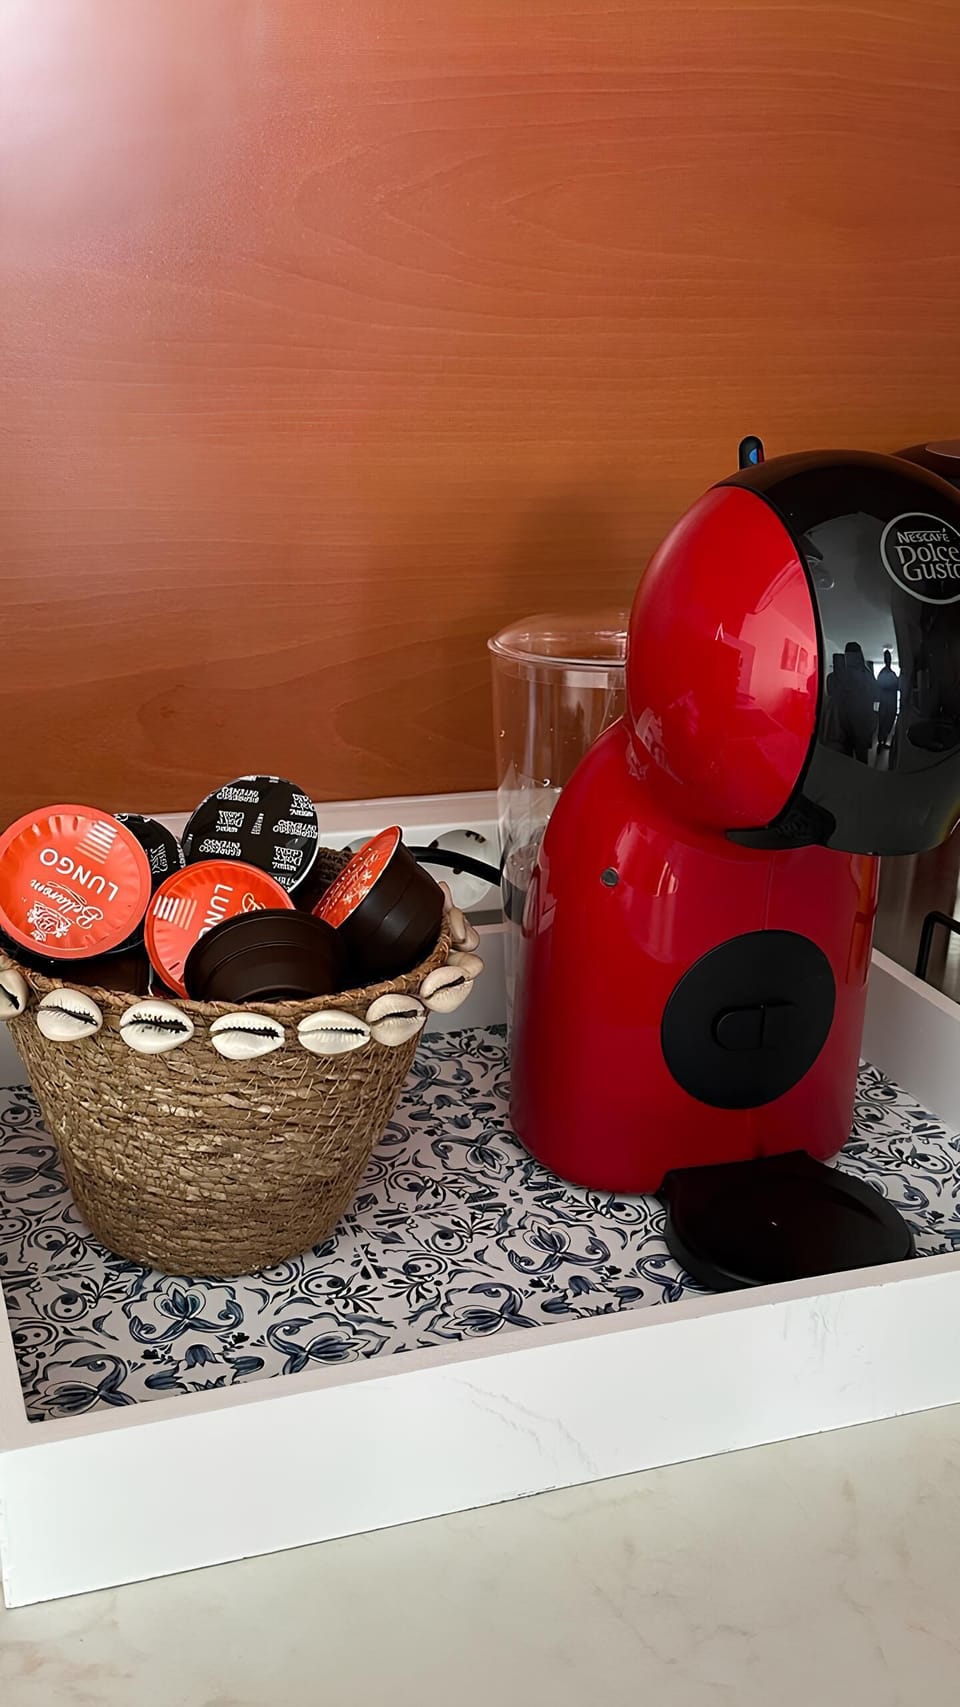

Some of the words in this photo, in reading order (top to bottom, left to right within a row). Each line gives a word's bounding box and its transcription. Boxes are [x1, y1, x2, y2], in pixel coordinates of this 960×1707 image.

[893, 543, 960, 564] Dolce
[40, 848, 119, 902] LUNGO
[198, 884, 234, 939] LUN
